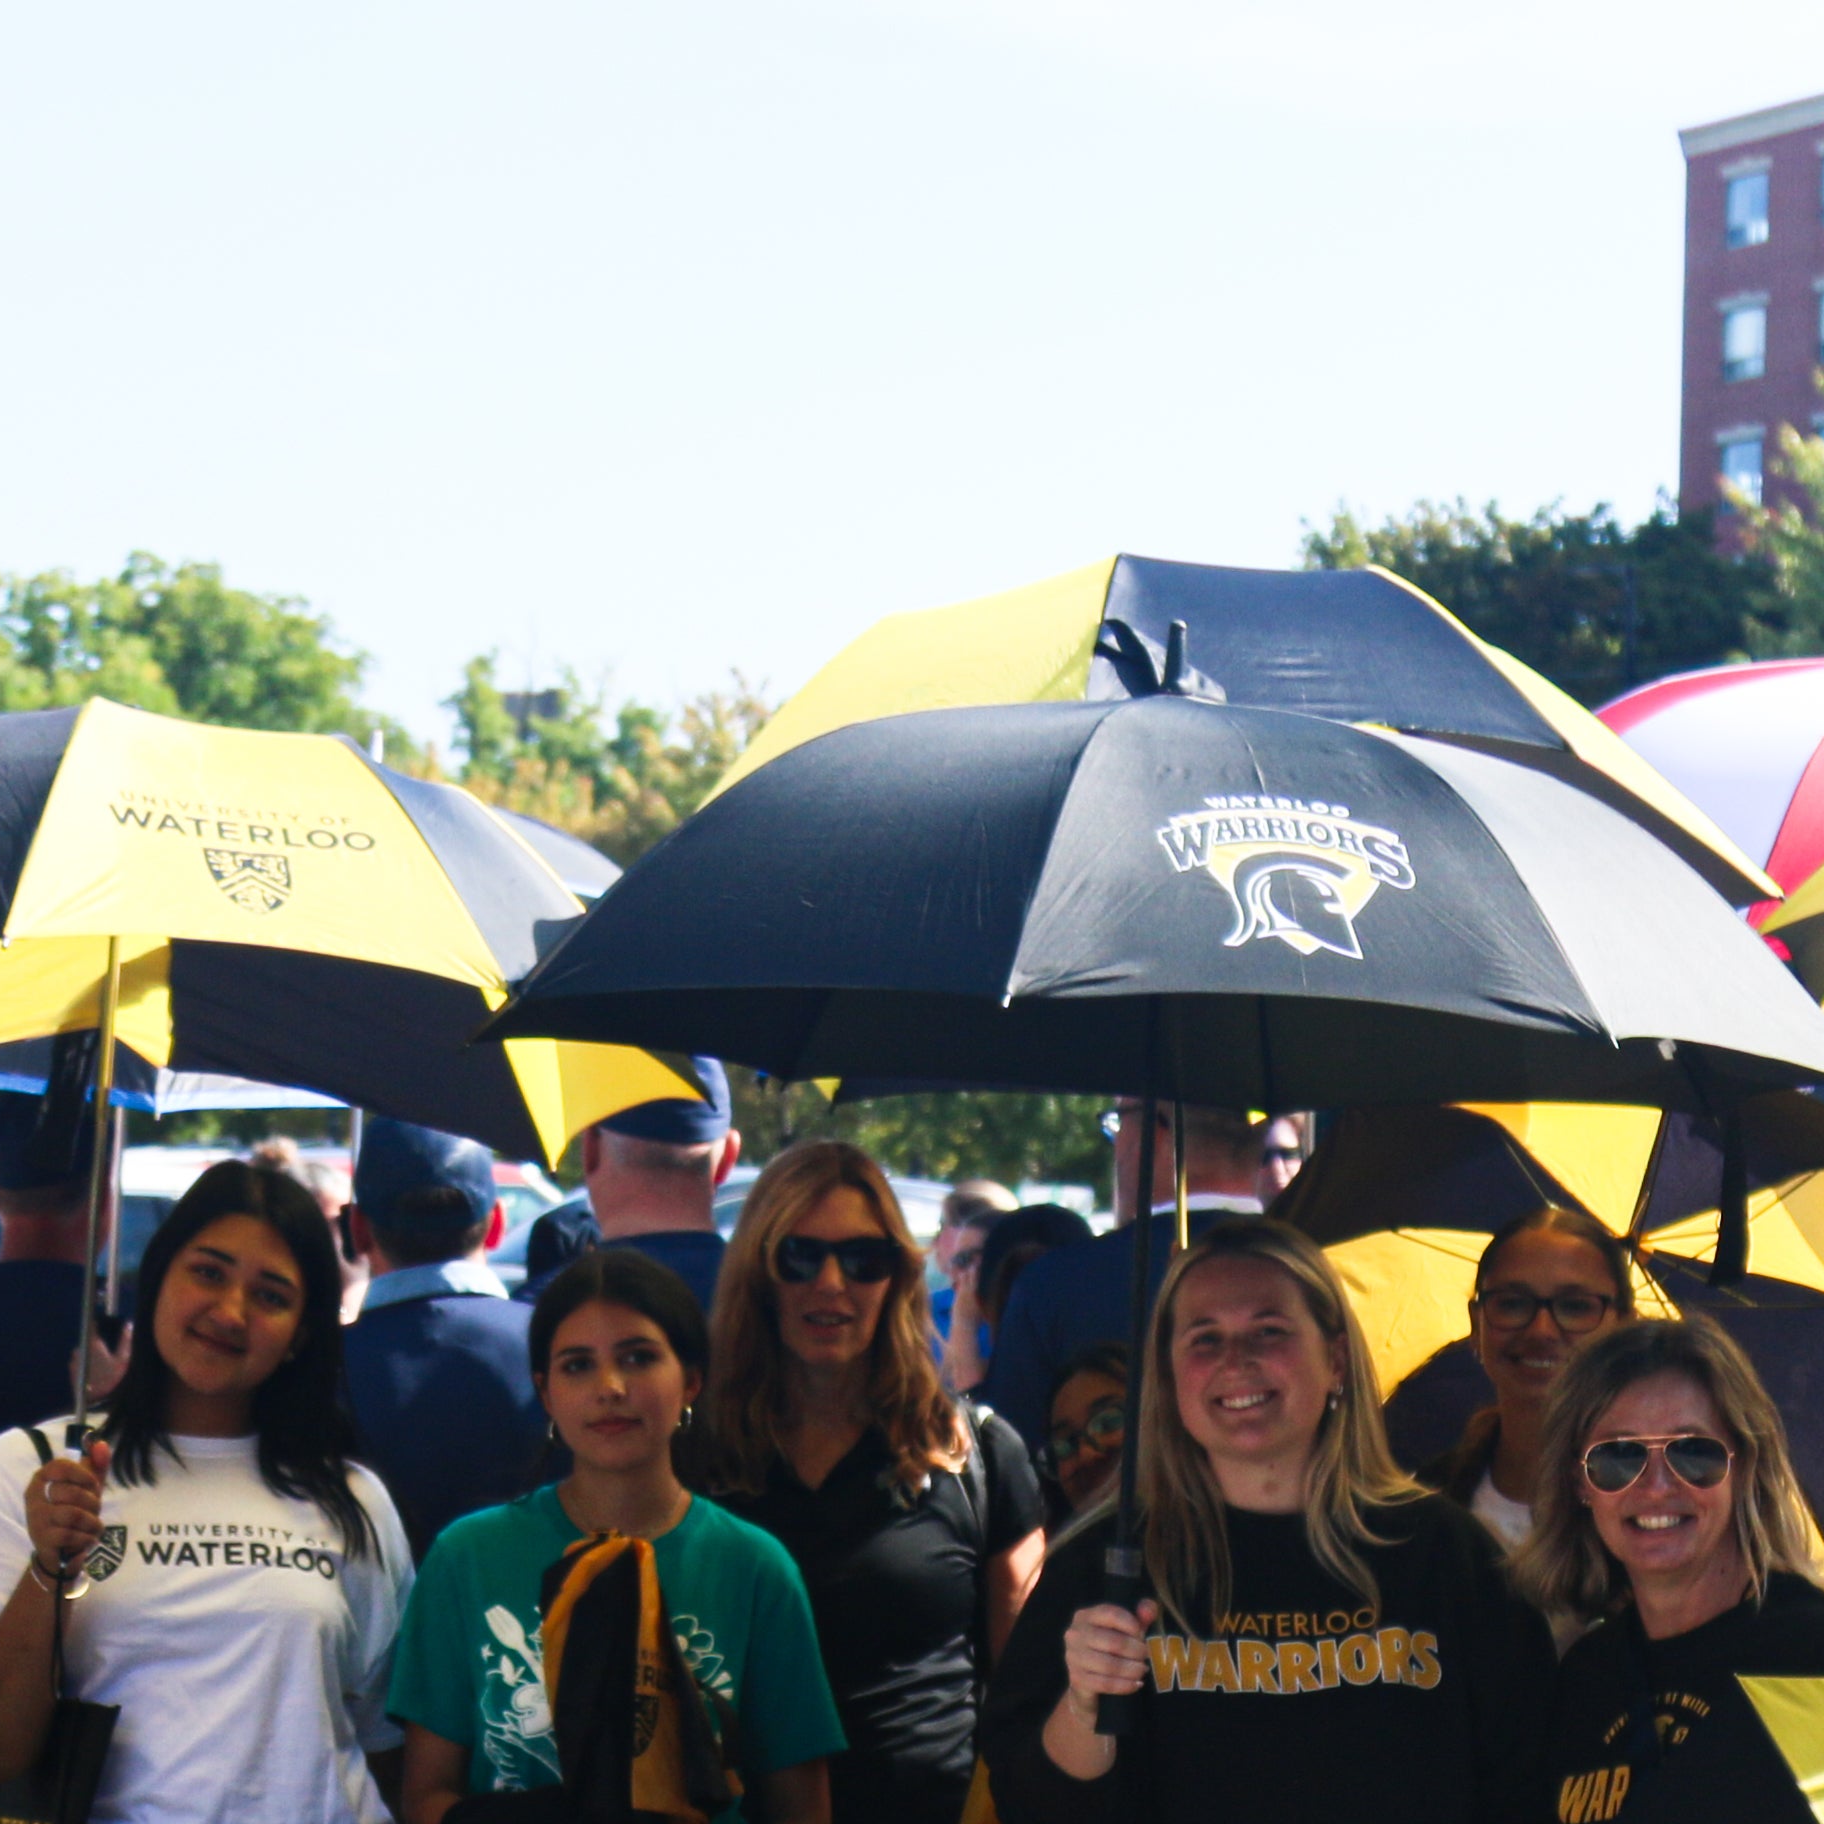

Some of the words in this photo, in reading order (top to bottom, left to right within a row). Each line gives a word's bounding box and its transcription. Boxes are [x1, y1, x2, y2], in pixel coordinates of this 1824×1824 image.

[119, 791, 300, 822] UNIVERSITY
[319, 815, 353, 826] OF
[1203, 795, 1350, 818] WATERLOO
[109, 803, 376, 851] WATERLOO
[1157, 815, 1416, 890] WARRIORS
[149, 1523, 293, 1540] UNIVERSITY
[136, 1540, 336, 1581] WATERLOO
[1216, 1607, 1377, 1637] WATERLOO
[1146, 1626, 1442, 1695] WARRIORS
